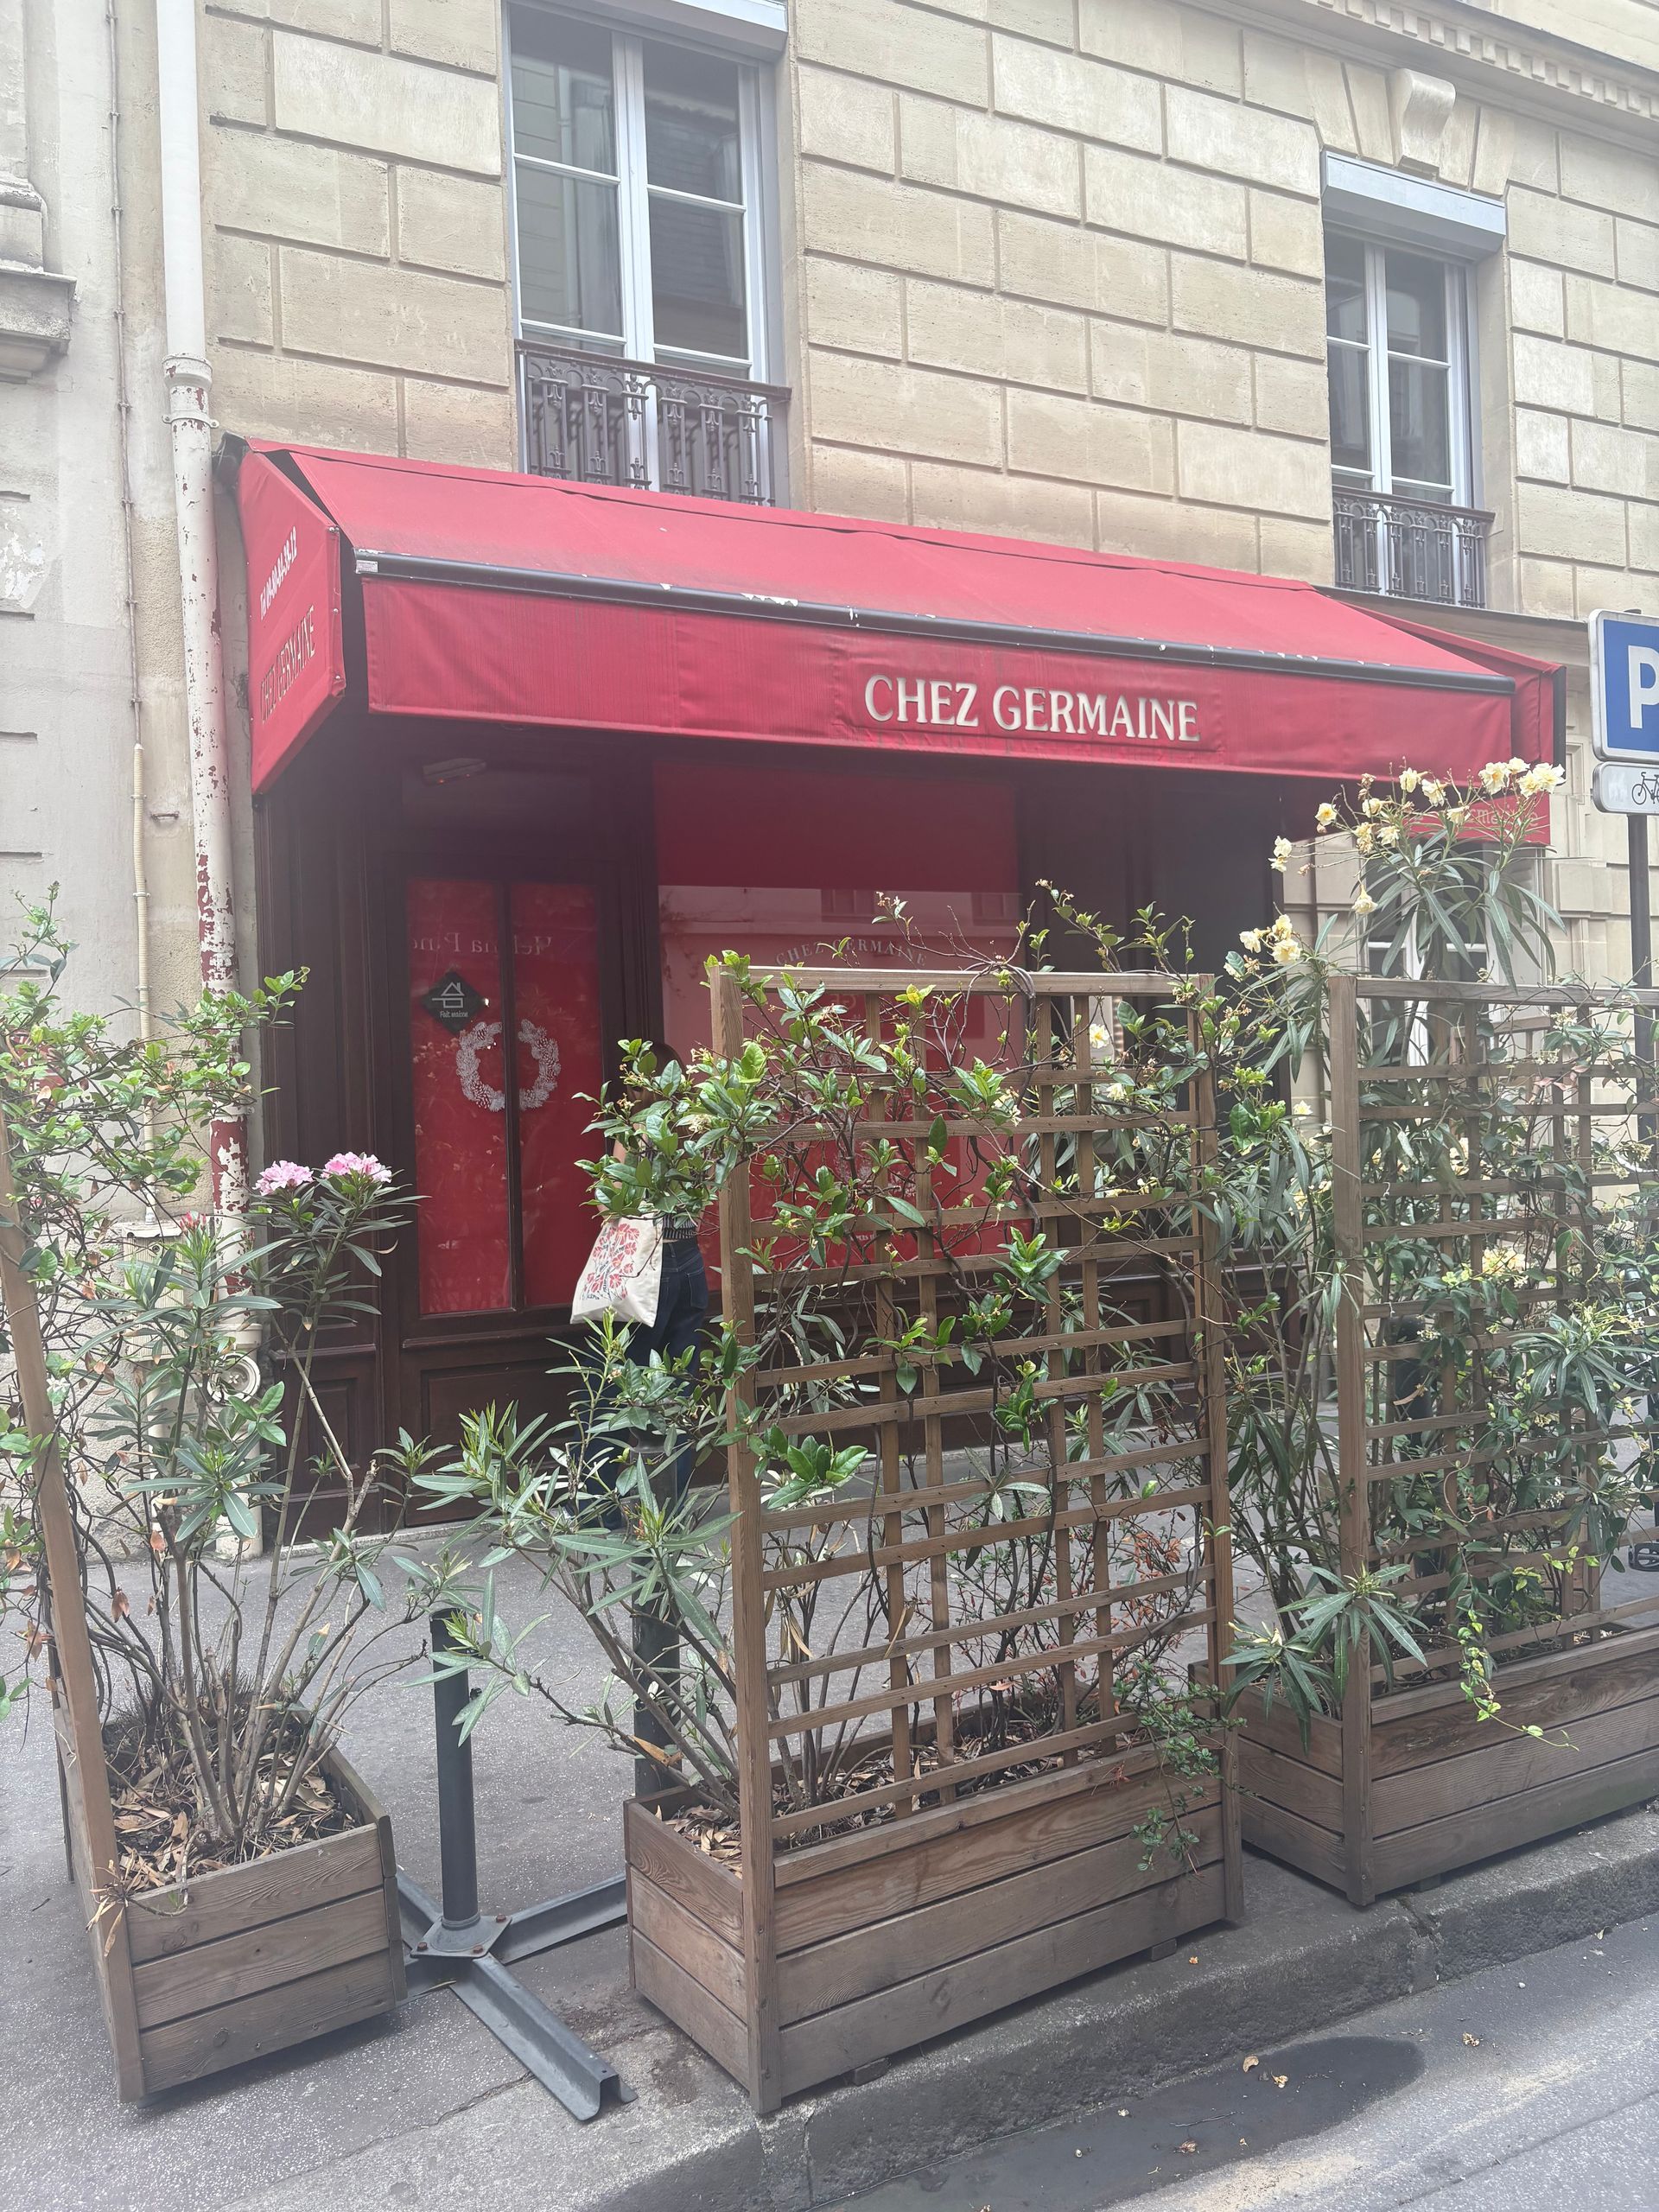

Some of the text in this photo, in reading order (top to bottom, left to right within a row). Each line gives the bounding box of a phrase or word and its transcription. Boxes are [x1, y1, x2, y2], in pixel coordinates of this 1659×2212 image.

[276, 604, 315, 702] GERMAINE
[1627, 645, 1659, 729] P
[864, 674, 1202, 743] CHEZ GERMAINE
